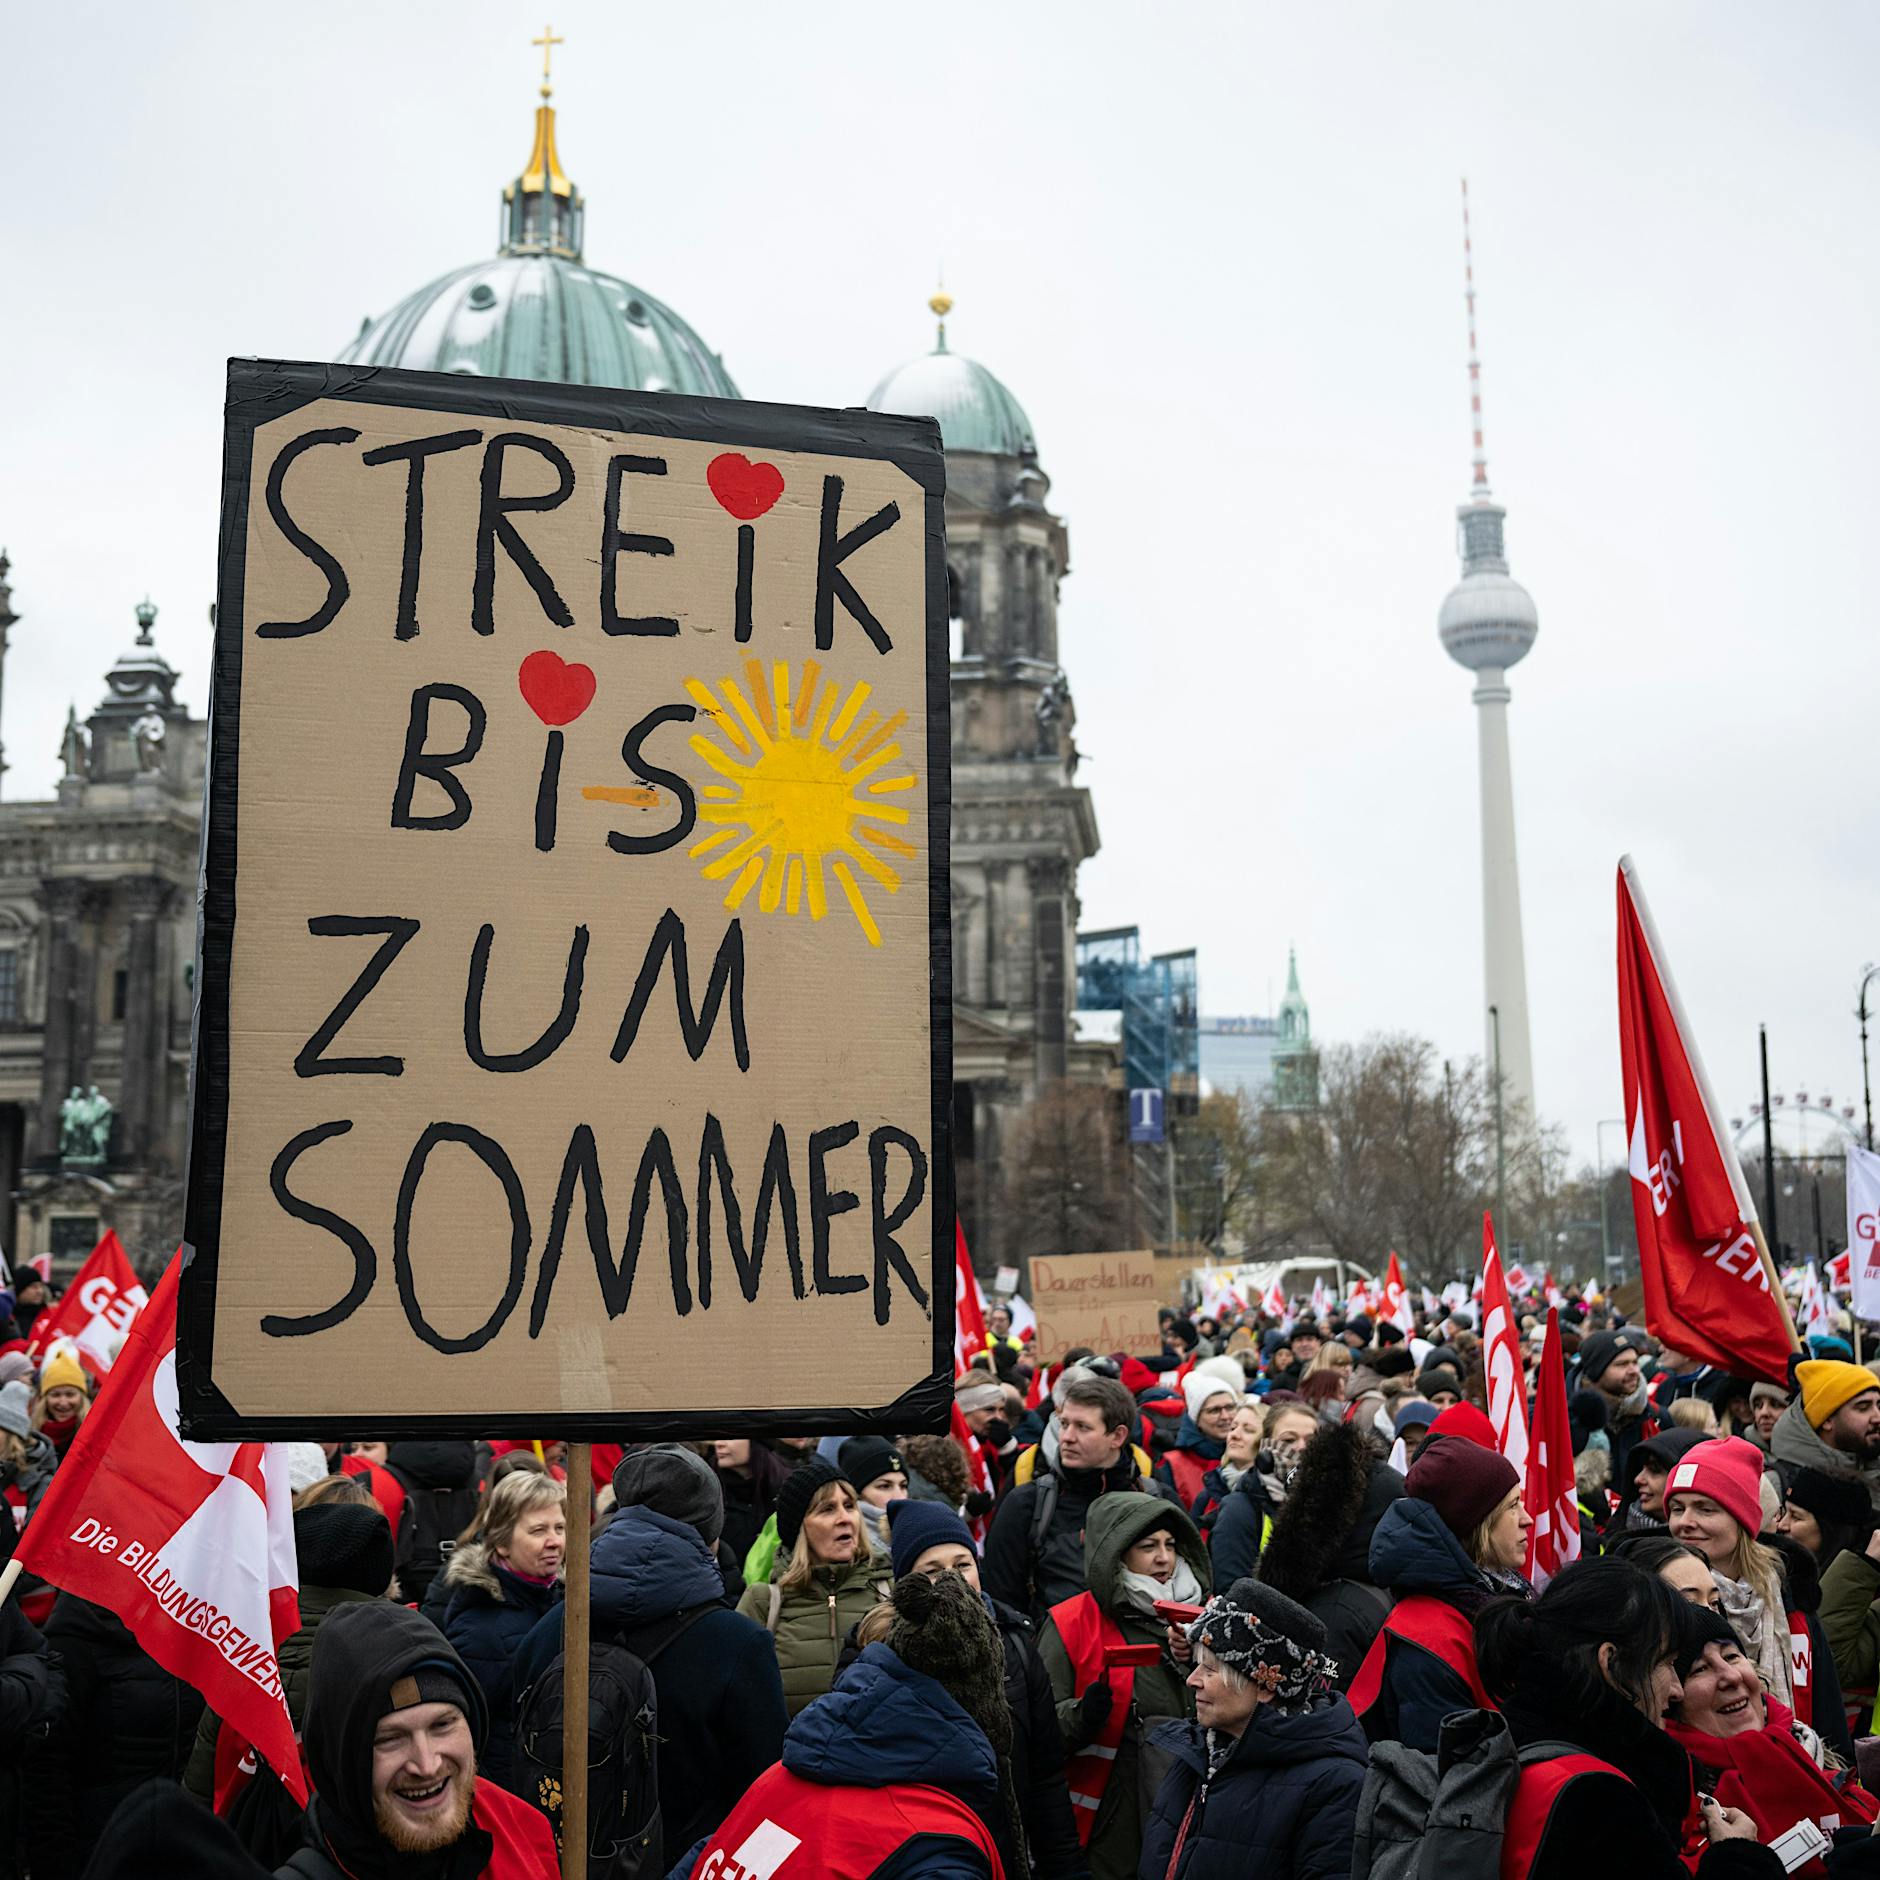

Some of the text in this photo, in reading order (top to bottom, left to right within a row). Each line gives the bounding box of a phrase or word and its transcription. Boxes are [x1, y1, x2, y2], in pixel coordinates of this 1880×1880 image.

[294, 908, 749, 1078] ZUM
[260, 1112, 929, 1355] SOMMER
[70, 1517, 119, 1554] Die
